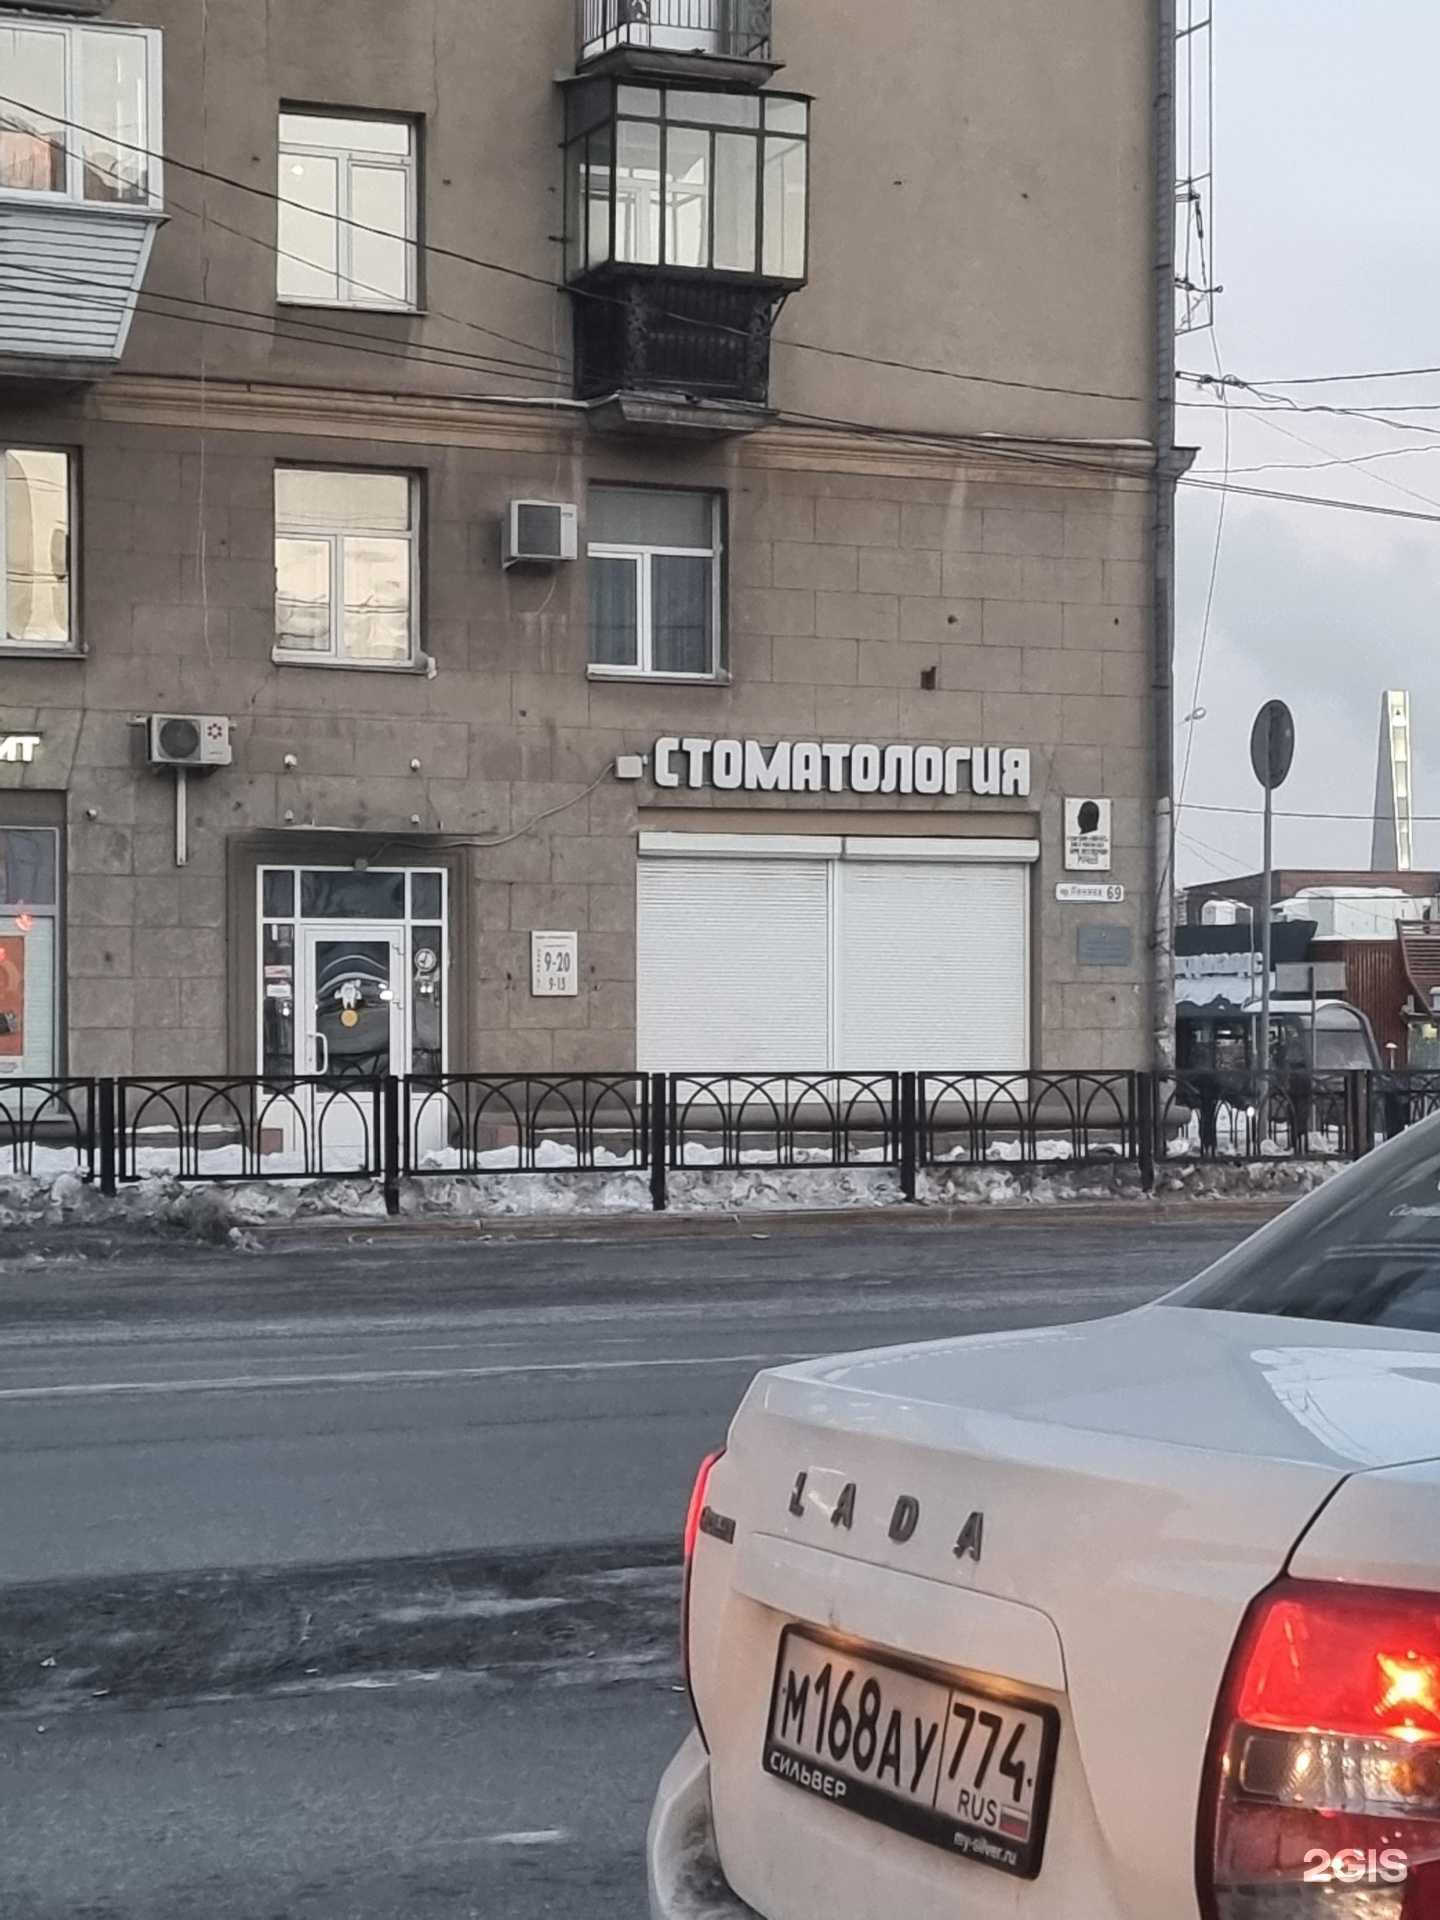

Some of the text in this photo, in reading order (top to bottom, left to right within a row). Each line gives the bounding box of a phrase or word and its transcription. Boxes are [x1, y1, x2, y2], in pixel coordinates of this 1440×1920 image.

[654, 737, 1031, 796] СТОМАТОЛОГИЯ
[1107, 886, 1121, 899] 69
[544, 952, 570, 972] 9-20
[788, 1471, 984, 1562] LADA
[769, 1751, 847, 1799] СИЛЬВЕР
[949, 1702, 1026, 1802] 774
[958, 1788, 998, 1827] RUS
